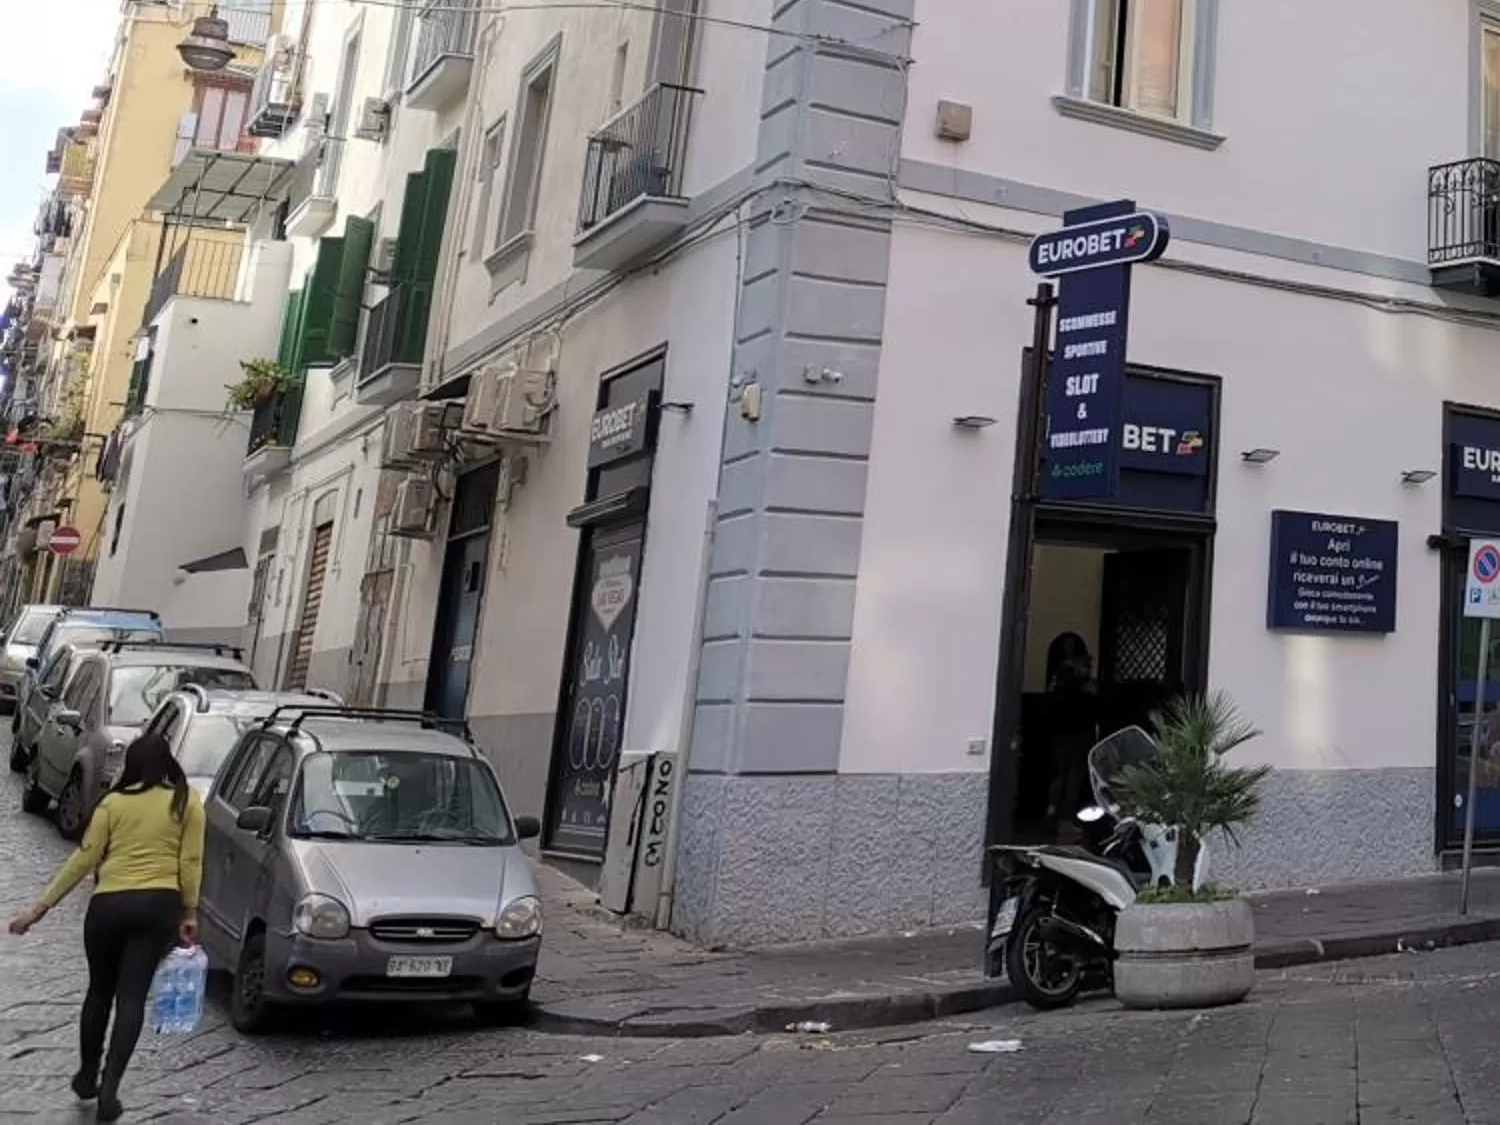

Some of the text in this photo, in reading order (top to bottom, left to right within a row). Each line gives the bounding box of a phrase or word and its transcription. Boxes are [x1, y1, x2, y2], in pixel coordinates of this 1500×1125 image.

[1037, 228, 1126, 264] EUROBET
[1059, 310, 1117, 332] SCOMMESSE
[1063, 340, 1107, 359] SPORTIVE
[1065, 373, 1099, 396] SLOT
[1077, 402, 1087, 419] &
[1311, 521, 1356, 534] EUROBET
[1299, 553, 1318, 566] tuo
